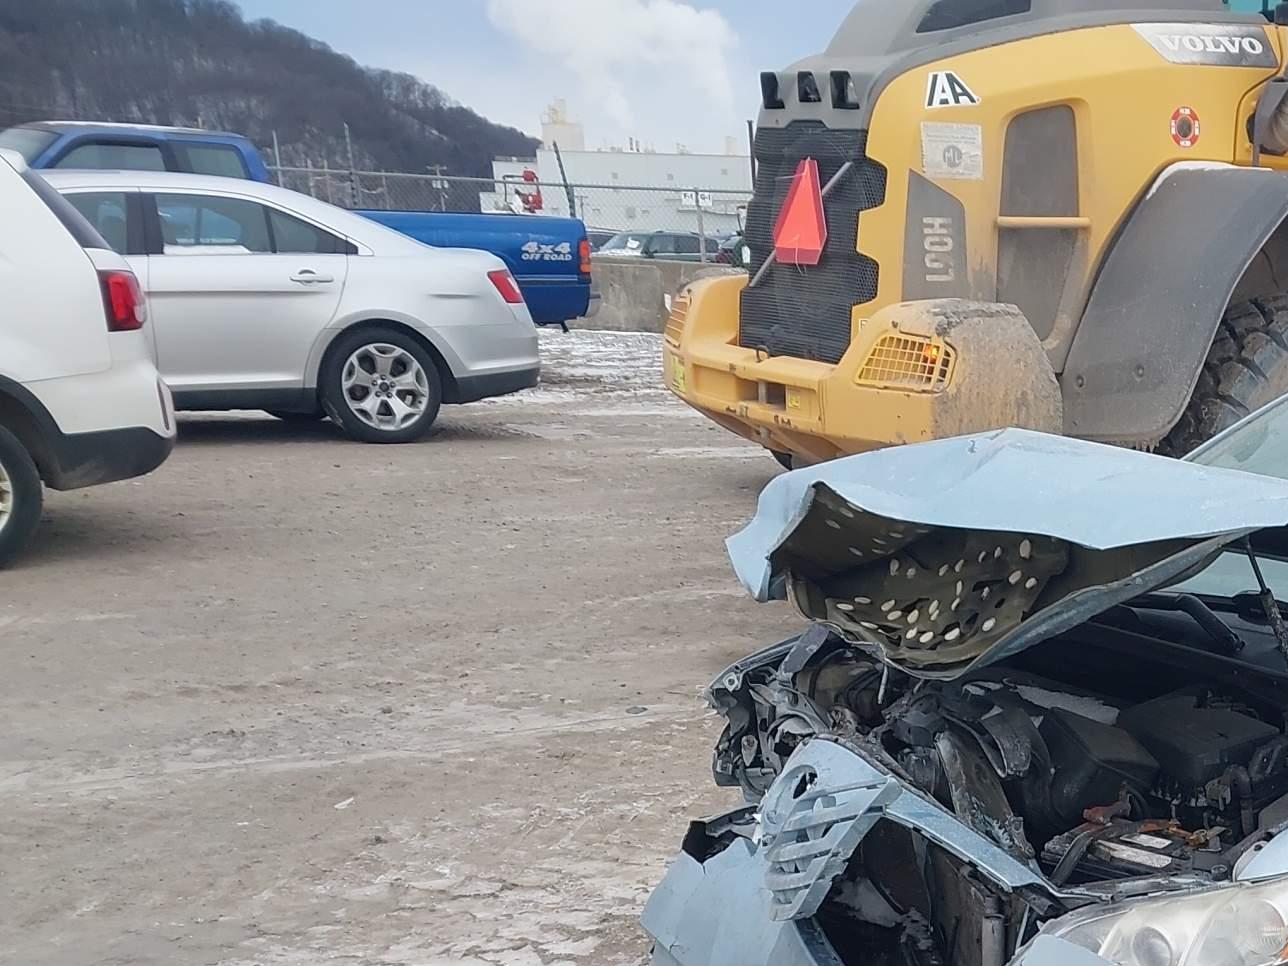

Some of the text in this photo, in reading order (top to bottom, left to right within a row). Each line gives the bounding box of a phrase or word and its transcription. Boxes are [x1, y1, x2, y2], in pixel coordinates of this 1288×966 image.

[1159, 34, 1263, 55] VOLVO
[926, 72, 978, 107] IAA
[521, 253, 573, 261] OFF ROAD
